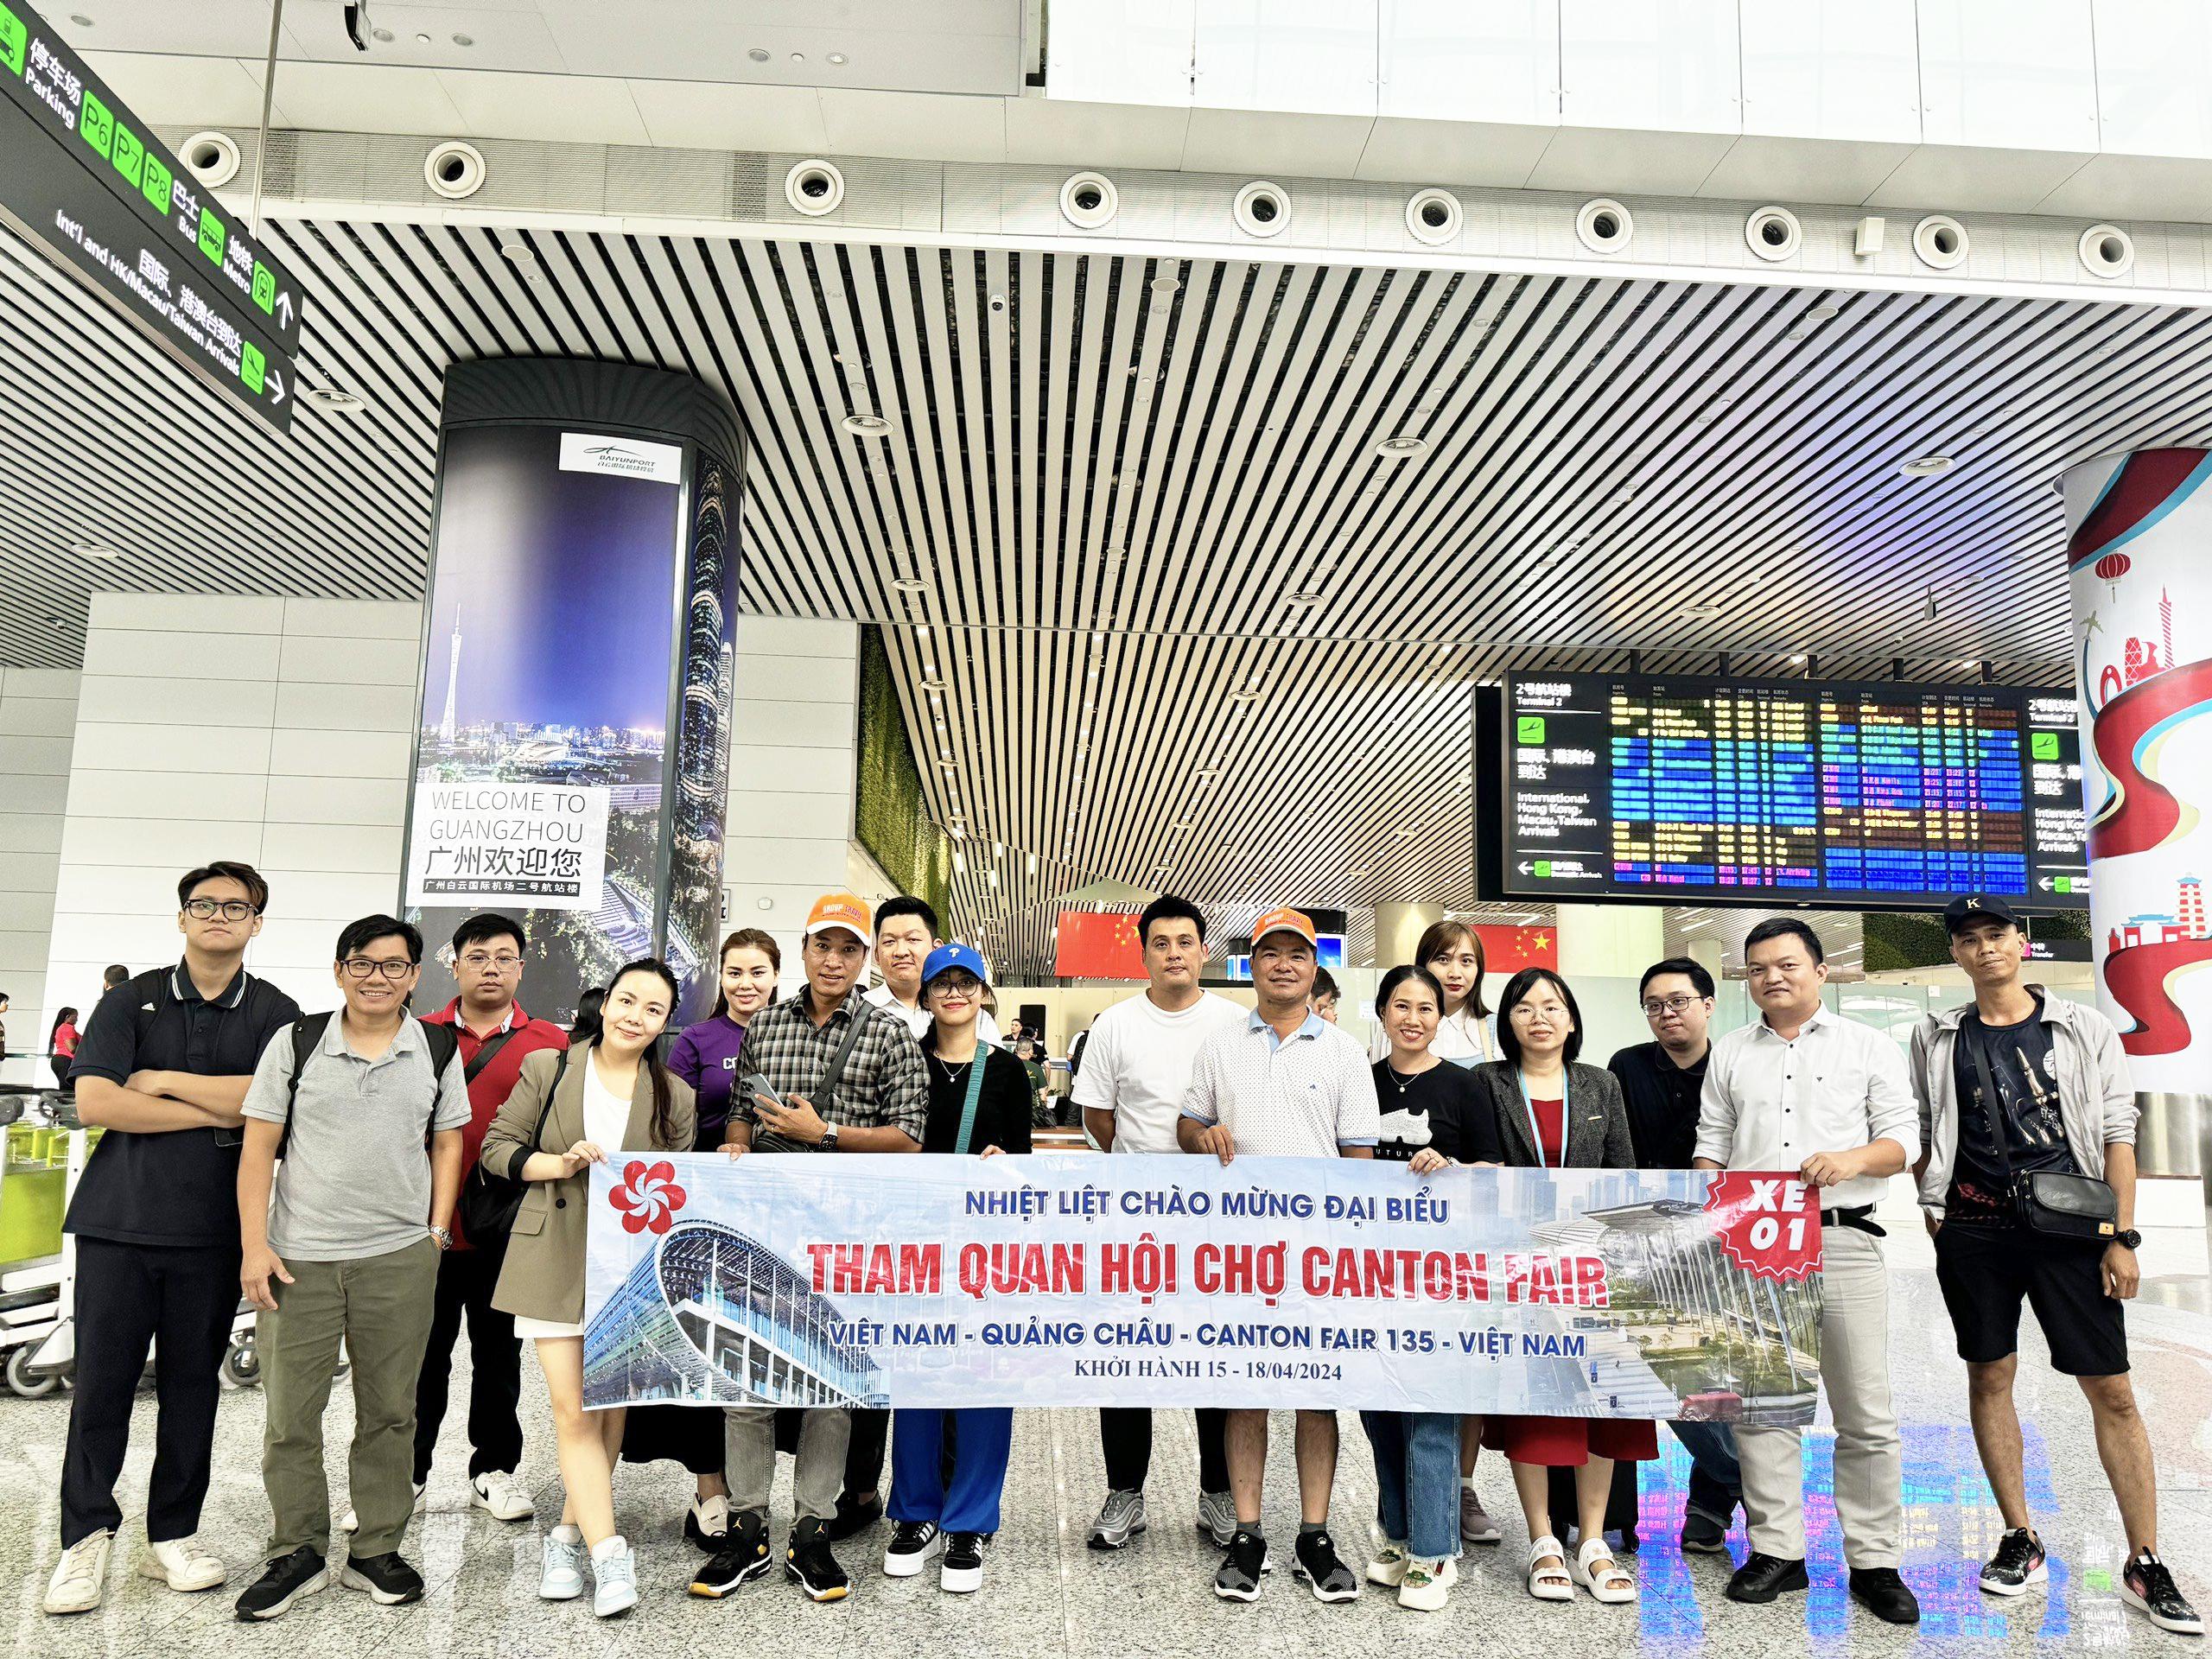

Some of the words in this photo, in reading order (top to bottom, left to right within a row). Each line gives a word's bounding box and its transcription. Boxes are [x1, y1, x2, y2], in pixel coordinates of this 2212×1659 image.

[30, 37, 81, 106] 停车场
[25, 67, 75, 130] Parking
[85, 102, 109, 146] P6
[116, 132, 140, 173] P7
[146, 162, 168, 202] P8
[173, 180, 200, 222] 巴士
[179, 215, 197, 243] Bus
[228, 235, 252, 276] 地铁
[223, 258, 251, 294] Metro
[56, 209, 83, 244] Int'l
[84, 237, 109, 265] and
[110, 254, 205, 346] HK/Macau/Taiwan
[205, 338, 240, 377] Arrivals
[599, 454, 656, 467] BAIYUNPORT
[1516, 696, 1554, 706] Terminal
[1555, 697, 1563, 707] 2
[2029, 713, 2067, 722] Terminal
[2067, 714, 2075, 723] 2
[432, 791, 544, 811] WELCOME
[552, 793, 586, 813] TO
[1517, 803, 1548, 816] Hong
[1548, 804, 1583, 817] Kong,
[429, 819, 583, 843] GUANGZHOU
[1517, 825, 1560, 837] Arrivals
[2035, 818, 2065, 831] Hong
[424, 845, 582, 878] 广州欢迎您
[2037, 841, 2079, 853] Arrivals
[424, 880, 579, 894] 广州白云国际机场二号航站楼
[1966, 898, 1981, 909] K
[966, 1185, 1048, 1223] NHIỆT
[1059, 1185, 1110, 1223] LIỆT
[1121, 1185, 1211, 1217] CHÀO
[1221, 1186, 1314, 1220] MỪNG
[1323, 1195, 1377, 1229] ĐẠI
[1386, 1186, 1449, 1224] BIỂU
[1745, 1179, 1808, 1212] XE
[1749, 1217, 1806, 1251] 01
[807, 1243, 942, 1294] THAM
[958, 1243, 1085, 1300] QUAN
[1102, 1233, 1179, 1306] HỘI
[1193, 1241, 1288, 1307] CHỢ
[1302, 1247, 1491, 1302] CANTON
[1504, 1254, 1610, 1306] FAIR
[830, 1317, 885, 1351] VIỆT
[893, 1323, 957, 1346] NAM
[982, 1315, 1085, 1347] QUẢNG
[1093, 1316, 1173, 1347] CHÂU
[1196, 1323, 1311, 1349] CANTON
[1320, 1327, 1379, 1351] FAIR
[1387, 1329, 1434, 1352] 135
[1458, 1326, 1513, 1362] VIỆT
[1522, 1333, 1586, 1357] NAM
[1074, 1355, 1131, 1377] KHỞI
[1138, 1356, 1201, 1378] HÀNH
[1208, 1361, 1227, 1378] 15
[1246, 1362, 1343, 1382] 18/04/2024
